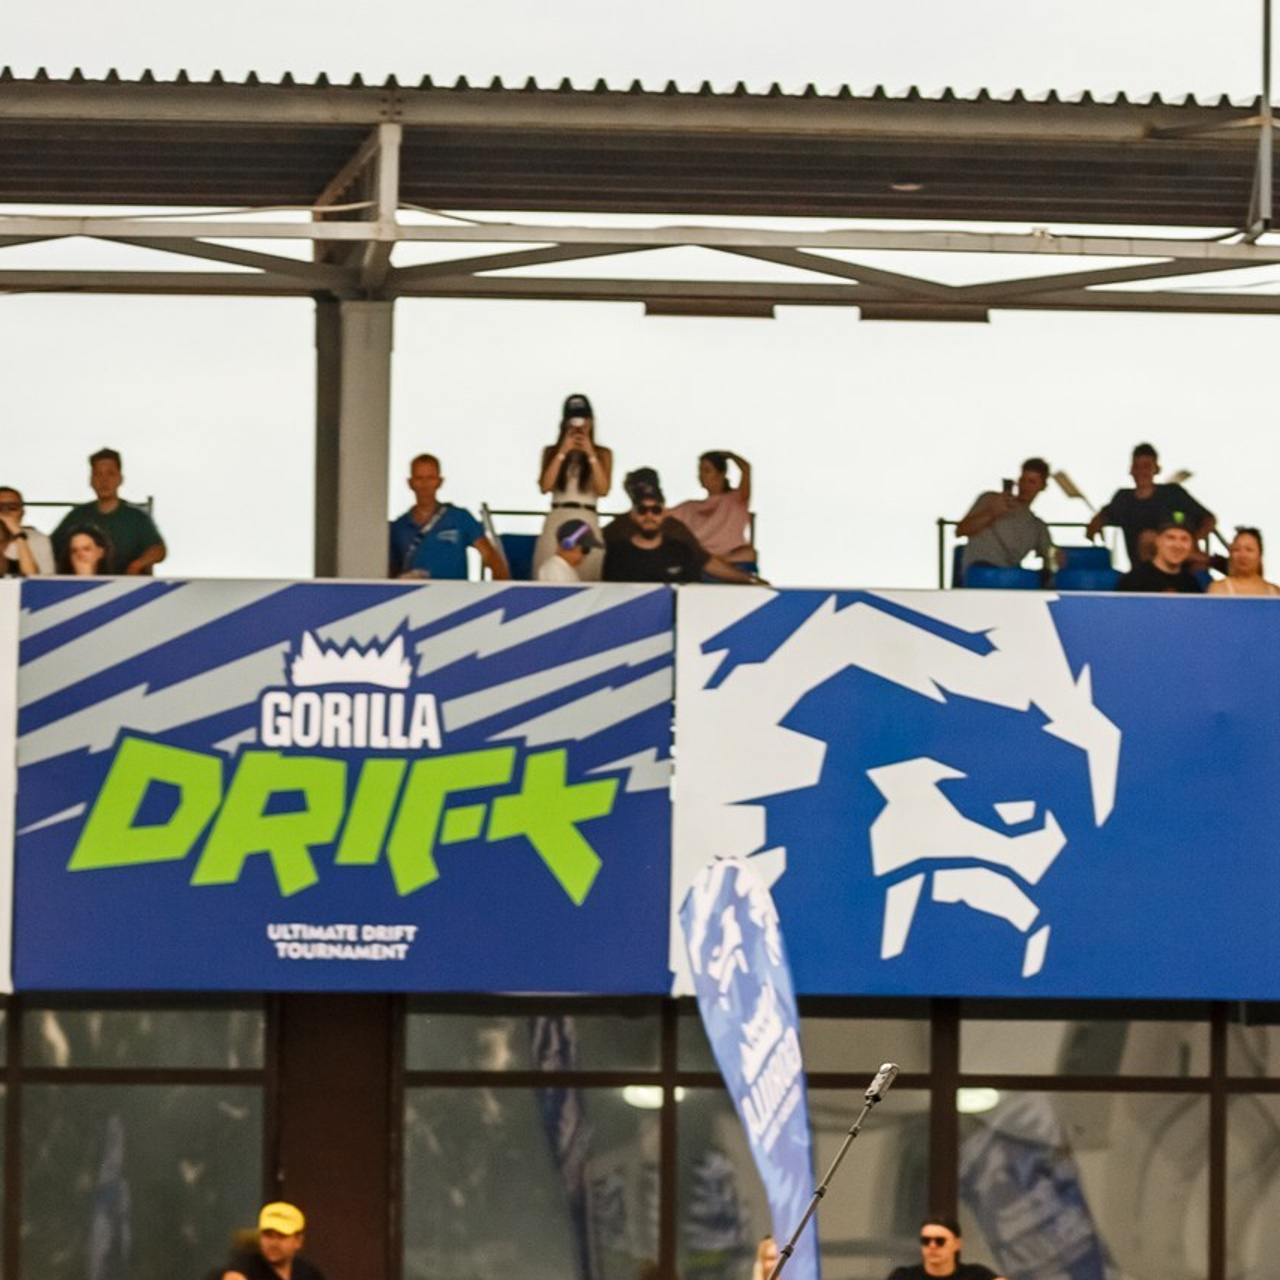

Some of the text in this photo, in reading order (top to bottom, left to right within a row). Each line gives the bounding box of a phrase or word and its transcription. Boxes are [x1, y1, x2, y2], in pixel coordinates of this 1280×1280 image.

[260, 691, 442, 749] GORILLA
[66, 736, 620, 906] DRIFT
[267, 923, 419, 942] ULTIMATE DRIFT
[275, 942, 409, 960] TOURNAMENT
